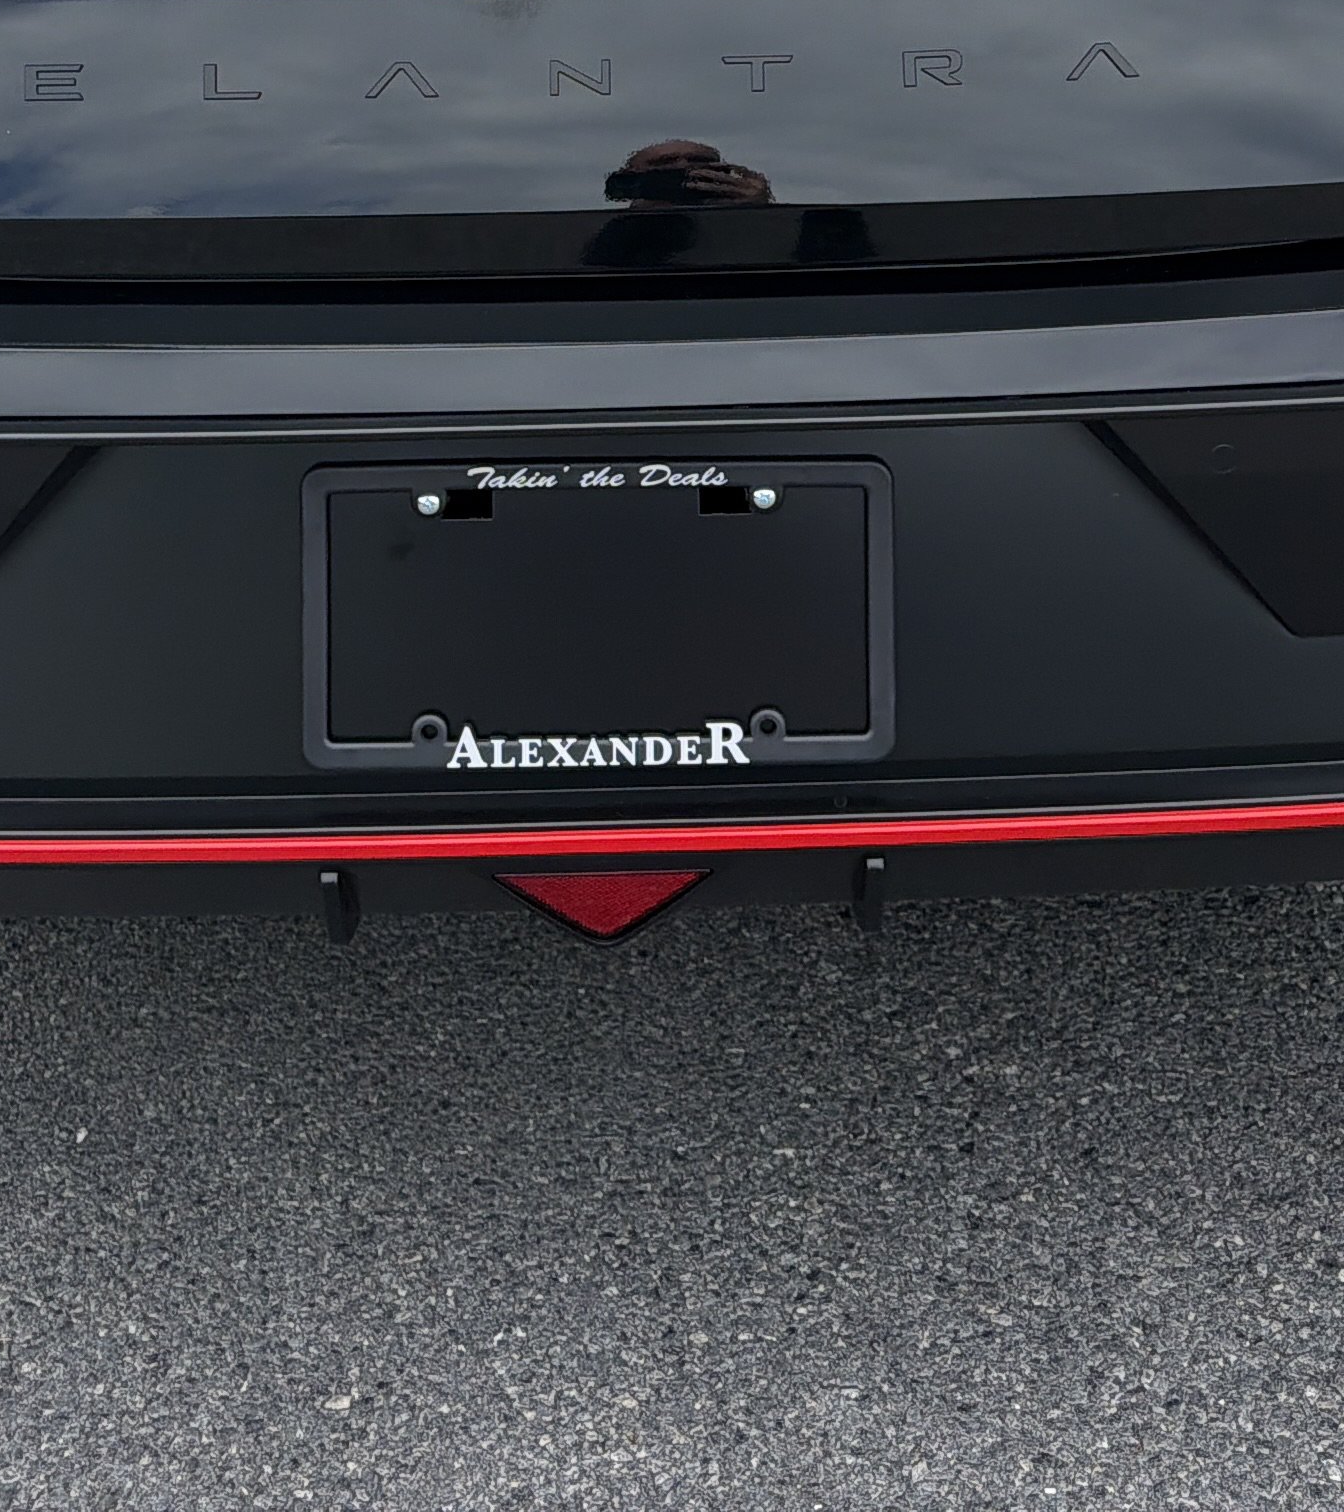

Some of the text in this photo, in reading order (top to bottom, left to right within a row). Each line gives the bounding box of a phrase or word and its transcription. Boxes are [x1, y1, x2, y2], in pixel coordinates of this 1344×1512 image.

[22, 40, 1142, 103] ELANTRA
[466, 464, 729, 490] Takin' the Deals
[446, 722, 751, 769] ALEXANDER
